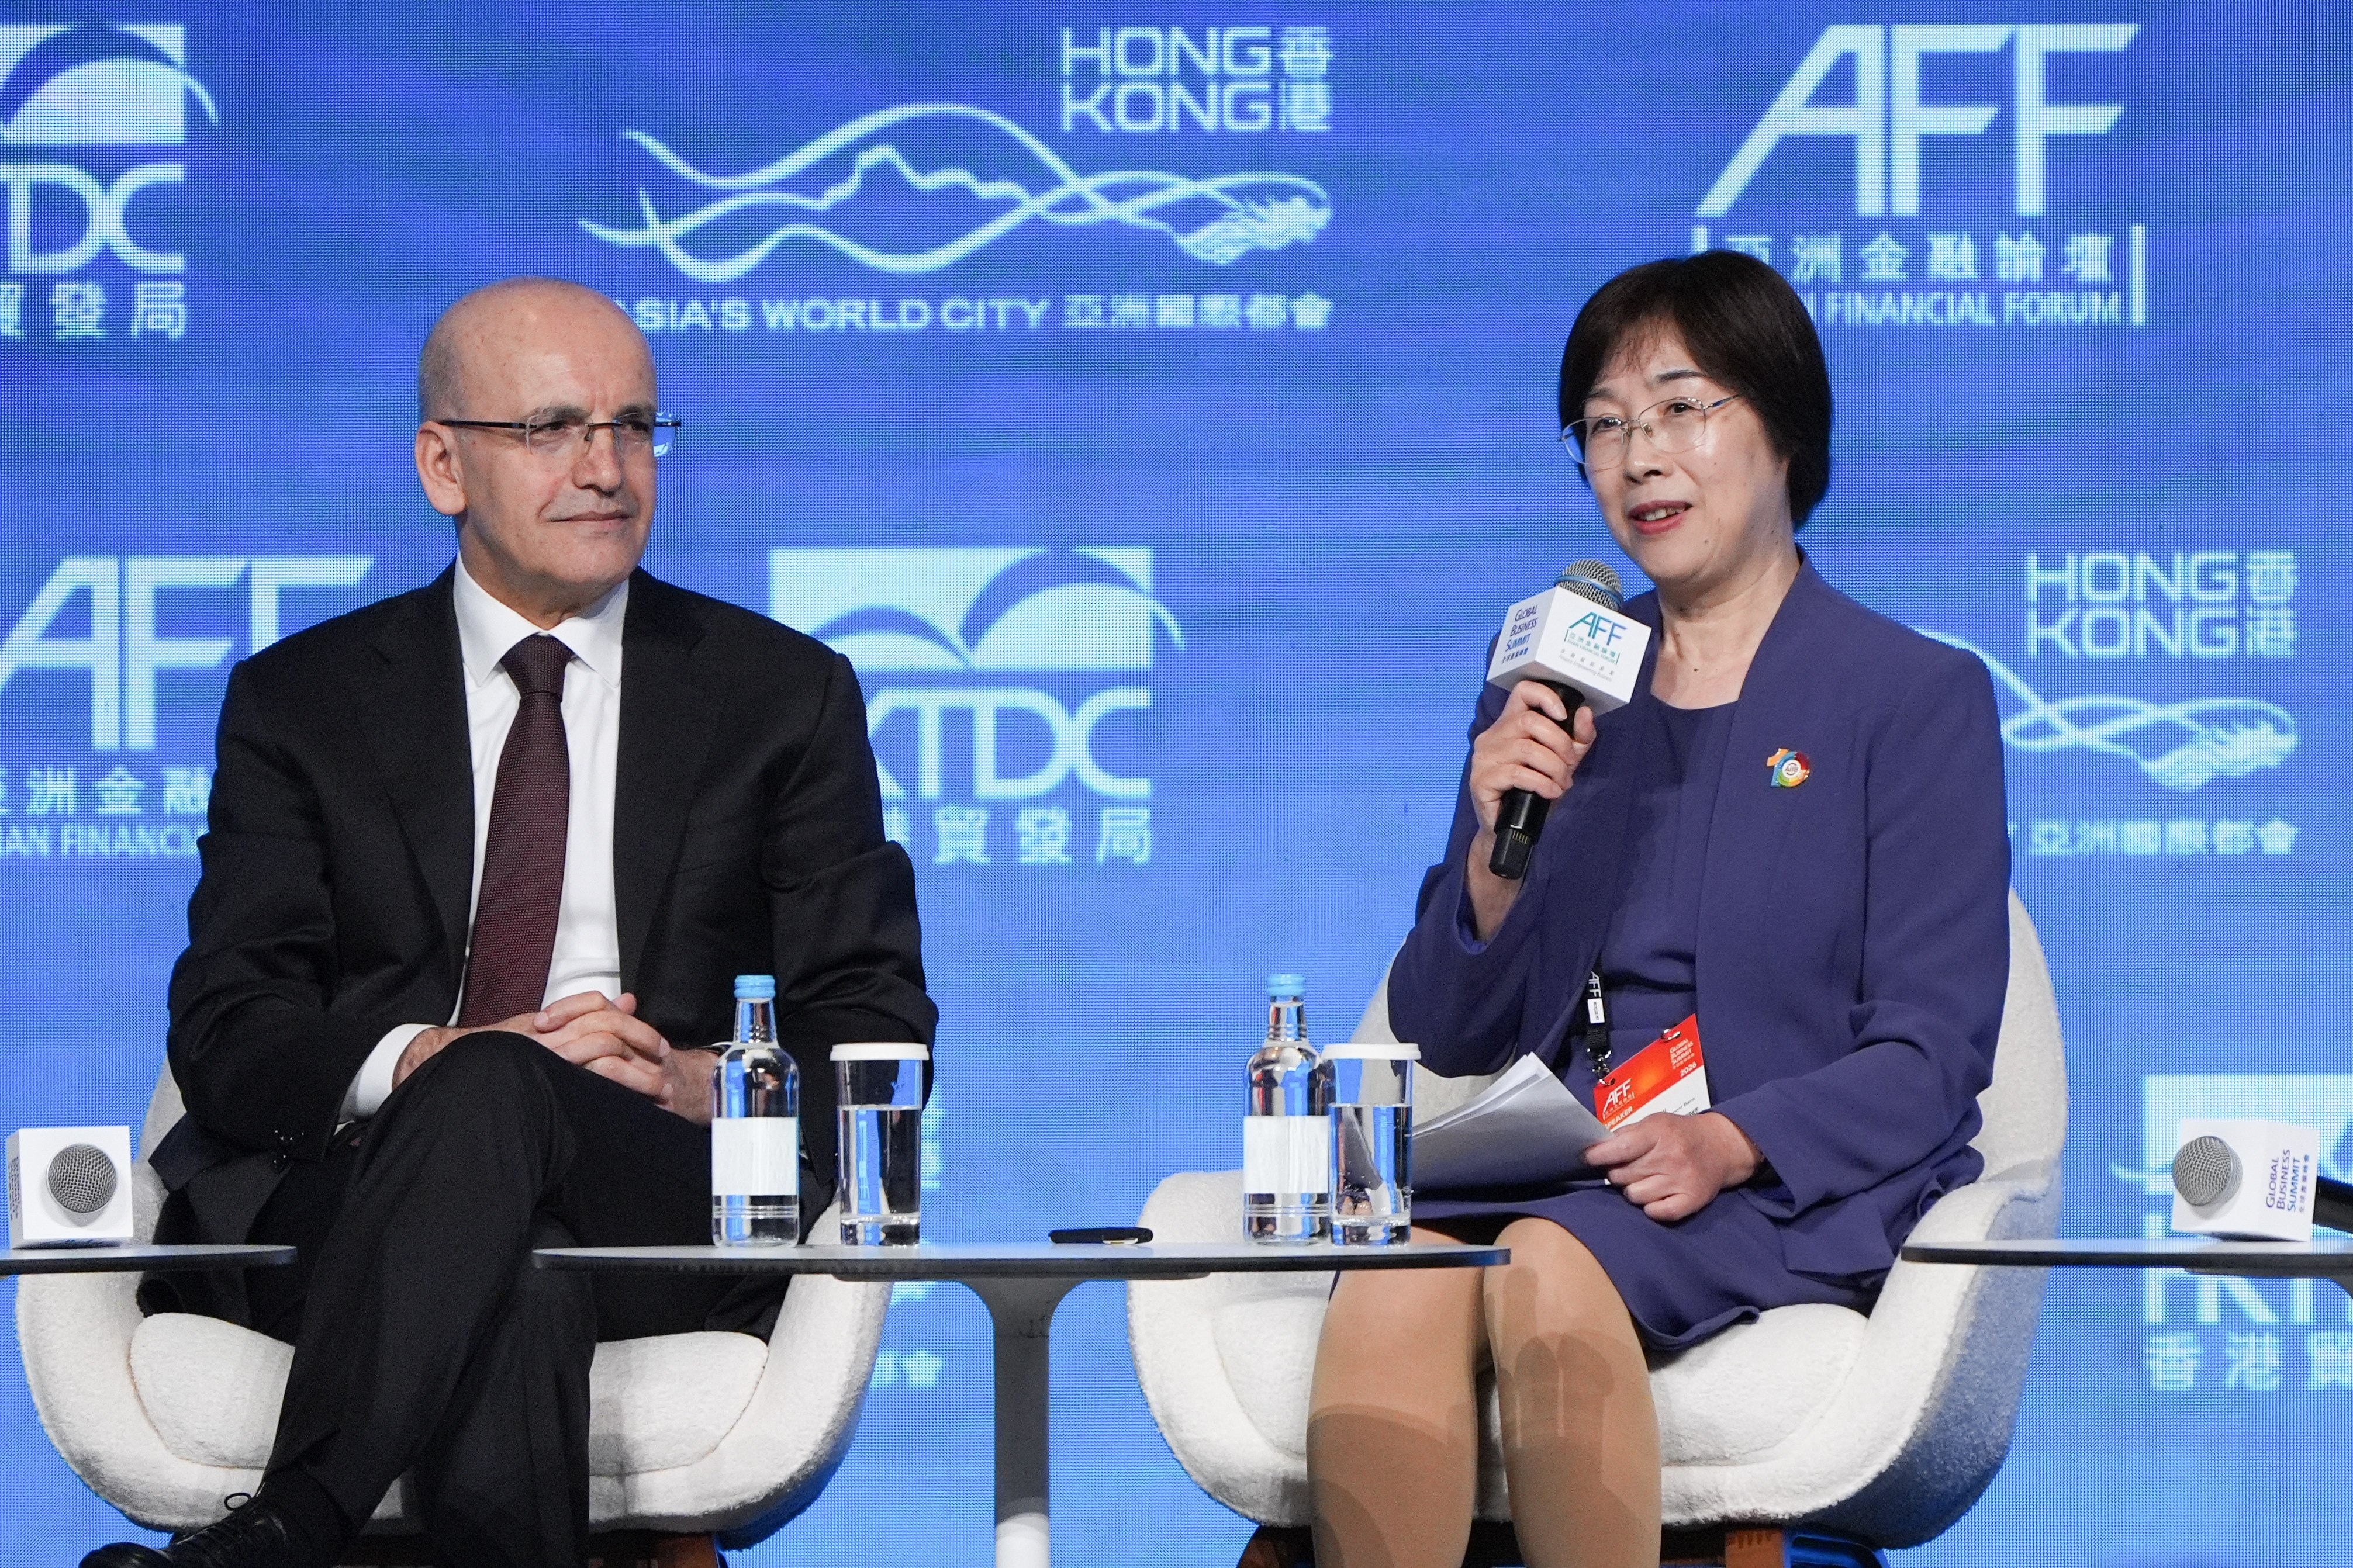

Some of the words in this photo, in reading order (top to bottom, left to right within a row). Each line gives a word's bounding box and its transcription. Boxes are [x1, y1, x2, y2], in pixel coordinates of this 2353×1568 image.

[1062, 27, 1272, 77] HONG
[1062, 81, 1272, 132] KONG
[1696, 23, 2139, 217] AFF
[0, 164, 185, 273] DC
[622, 298, 752, 332] SIA'S
[762, 298, 932, 331] WORLD
[939, 297, 1051, 331] CITY
[1825, 292, 1996, 326] FINANCIAL
[2004, 292, 2121, 326] FORUM
[2026, 551, 2238, 602] HONG
[1568, 611, 1628, 646] AFF
[2026, 607, 2239, 658] KONG
[0, 766, 209, 815] 洲金融
[1588, 970, 1602, 998] AFF
[1680, 1061, 1697, 1077] 2026
[1602, 1078, 1632, 1113] AFF
[2265, 1157, 2279, 1209] GLOBAL
[2276, 1148, 2290, 1210] BUSINESS
[2287, 1156, 2301, 1213] SUMMIT
